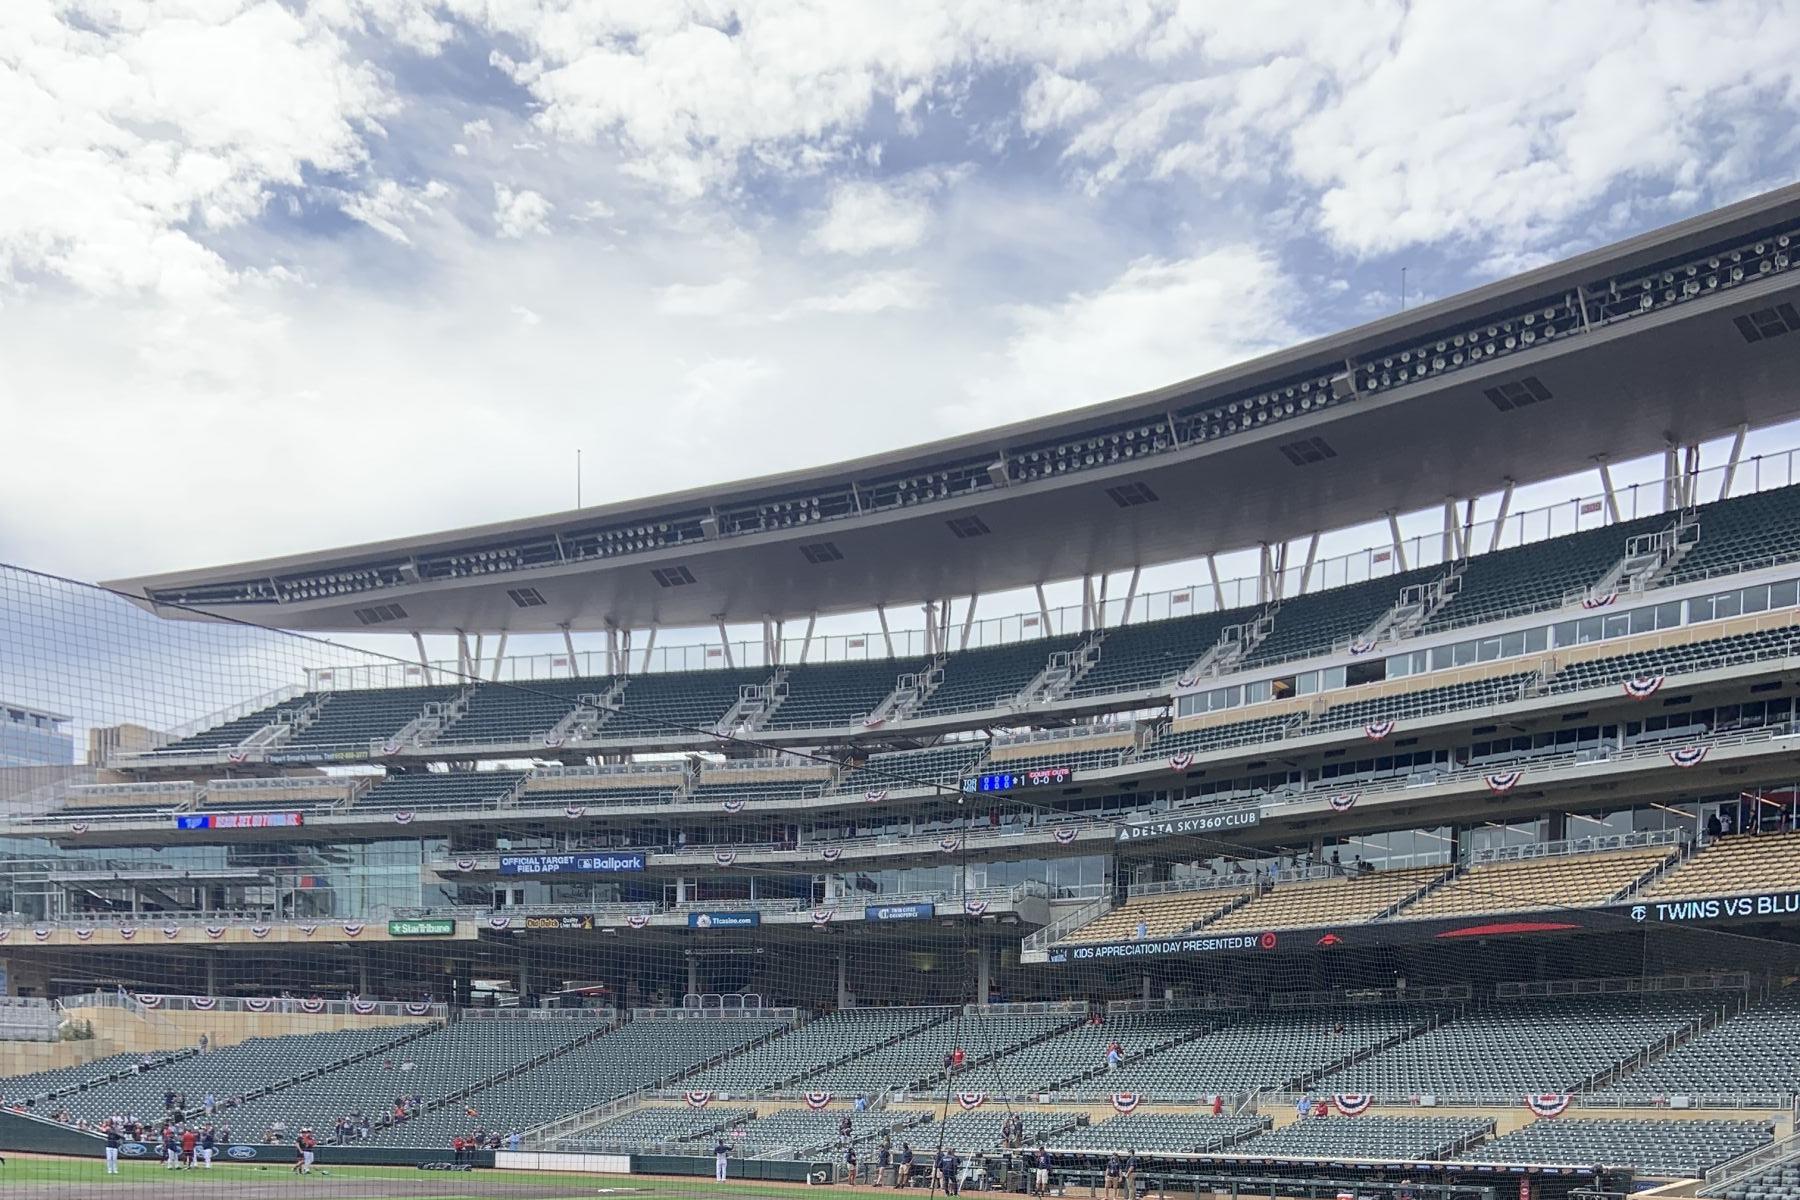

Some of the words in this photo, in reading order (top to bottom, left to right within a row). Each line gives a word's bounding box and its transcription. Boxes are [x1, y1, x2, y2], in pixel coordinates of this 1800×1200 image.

[1021, 775, 1025, 786] 1
[1033, 776, 1049, 785] 0-0
[1132, 824, 1173, 838] DELTA
[502, 857, 540, 866] OFFICIAL
[540, 856, 574, 864] TARGET
[593, 857, 641, 870] Ballpark
[517, 865, 540, 873] FIELD
[1656, 901, 1720, 921] TWINS
[1724, 898, 1752, 916] VS
[402, 923, 450, 933] StarTribune
[527, 918, 540, 928] Old
[540, 918, 559, 928] Dutch
[1074, 948, 1094, 958] KIDS
[1096, 943, 1161, 957] APPRECIATION
[1162, 942, 1181, 952] DAY
[1183, 938, 1242, 951] PRESENTED
[1244, 937, 1258, 946] BY
